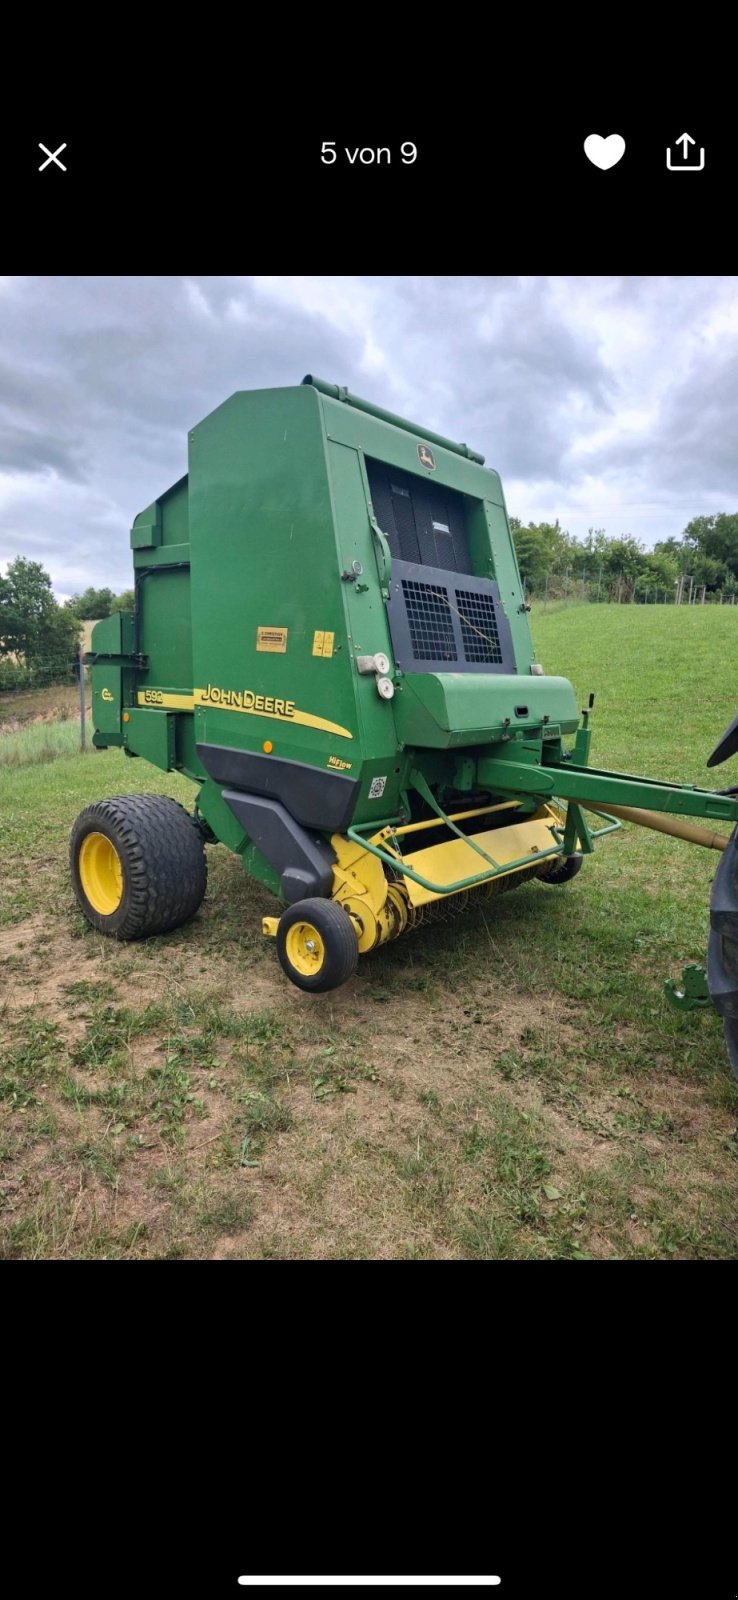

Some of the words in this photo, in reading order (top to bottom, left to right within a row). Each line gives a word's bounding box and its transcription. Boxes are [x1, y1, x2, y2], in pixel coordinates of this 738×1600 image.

[144, 690, 163, 704] 592
[201, 683, 242, 707] JOHN
[242, 689, 296, 717] DEERE
[328, 755, 353, 770] HiFlow
